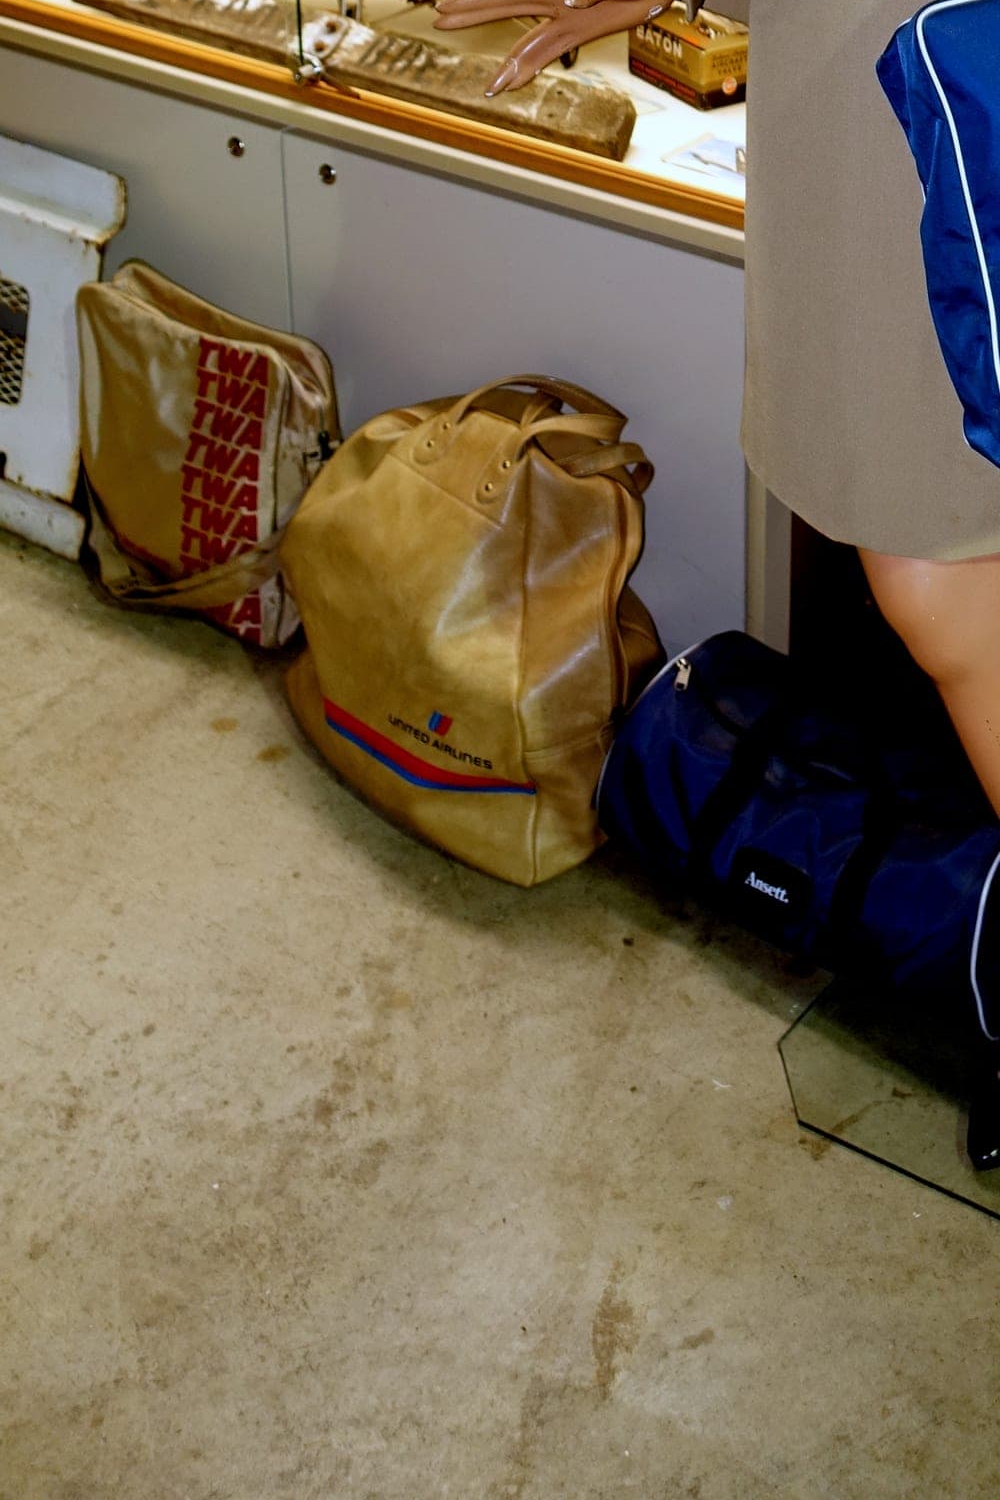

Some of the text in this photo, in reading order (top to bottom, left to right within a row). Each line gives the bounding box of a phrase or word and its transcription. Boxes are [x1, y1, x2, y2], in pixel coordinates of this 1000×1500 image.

[199, 336, 269, 388] TWA
[197, 368, 267, 418] TWA
[193, 398, 265, 451] TWA
[185, 431, 260, 482] TWA
[181, 465, 259, 512] TWA
[181, 496, 259, 542] TWA
[181, 525, 258, 564] TW
[388, 713, 493, 770] UNITED AIRLINES
